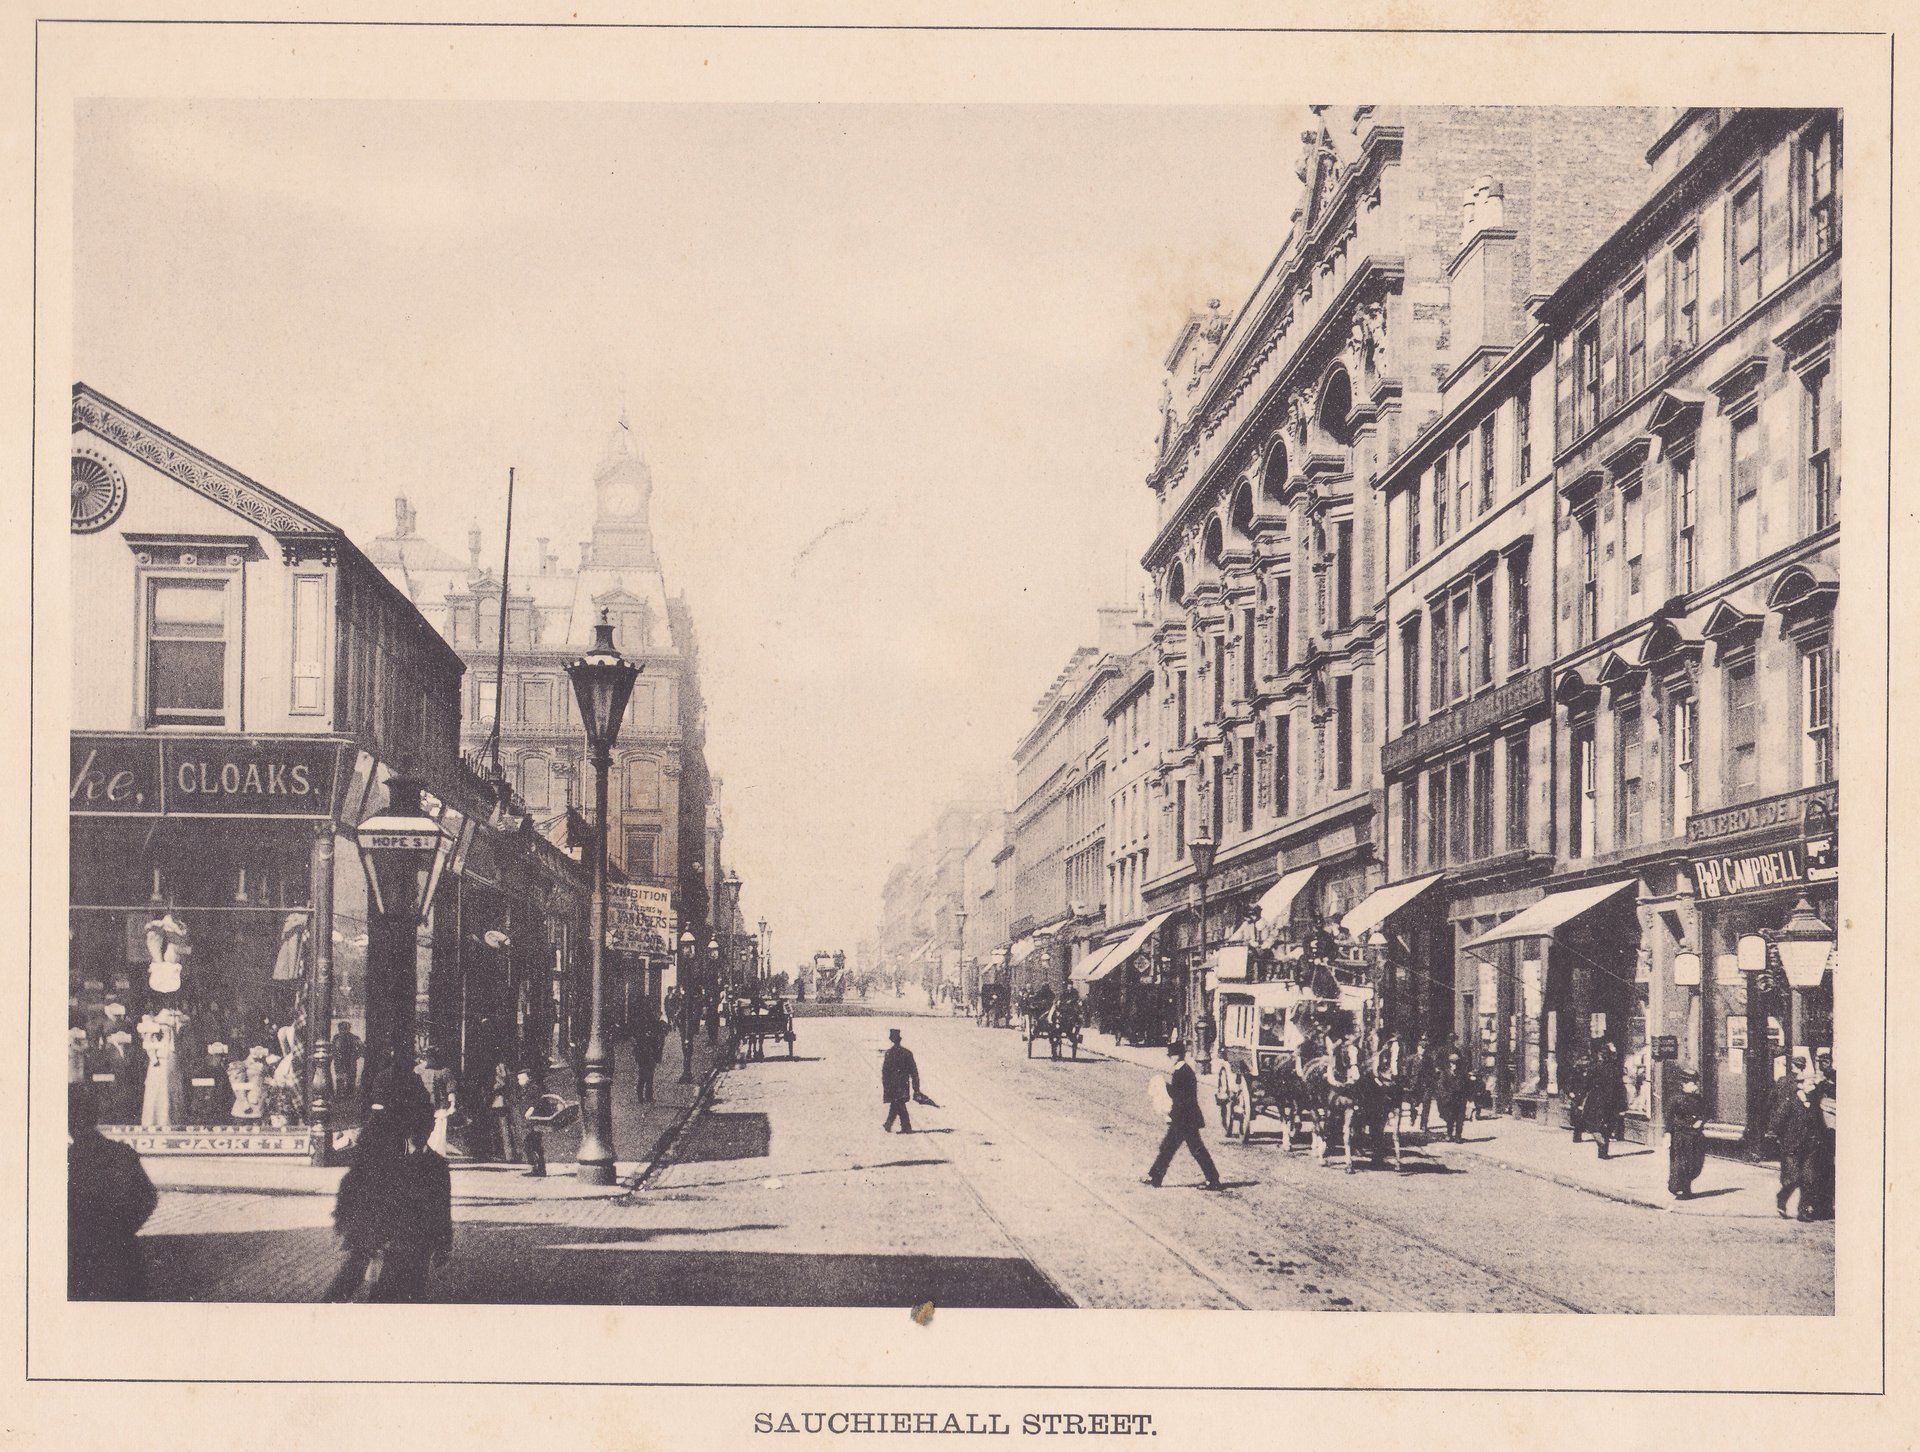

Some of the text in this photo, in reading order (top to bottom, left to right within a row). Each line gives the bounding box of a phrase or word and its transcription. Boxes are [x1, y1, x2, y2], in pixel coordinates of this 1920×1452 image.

[177, 762, 320, 795] CLOAKS.
[372, 836, 408, 847] HOPE
[1722, 850, 1803, 895] CAMPBELL
